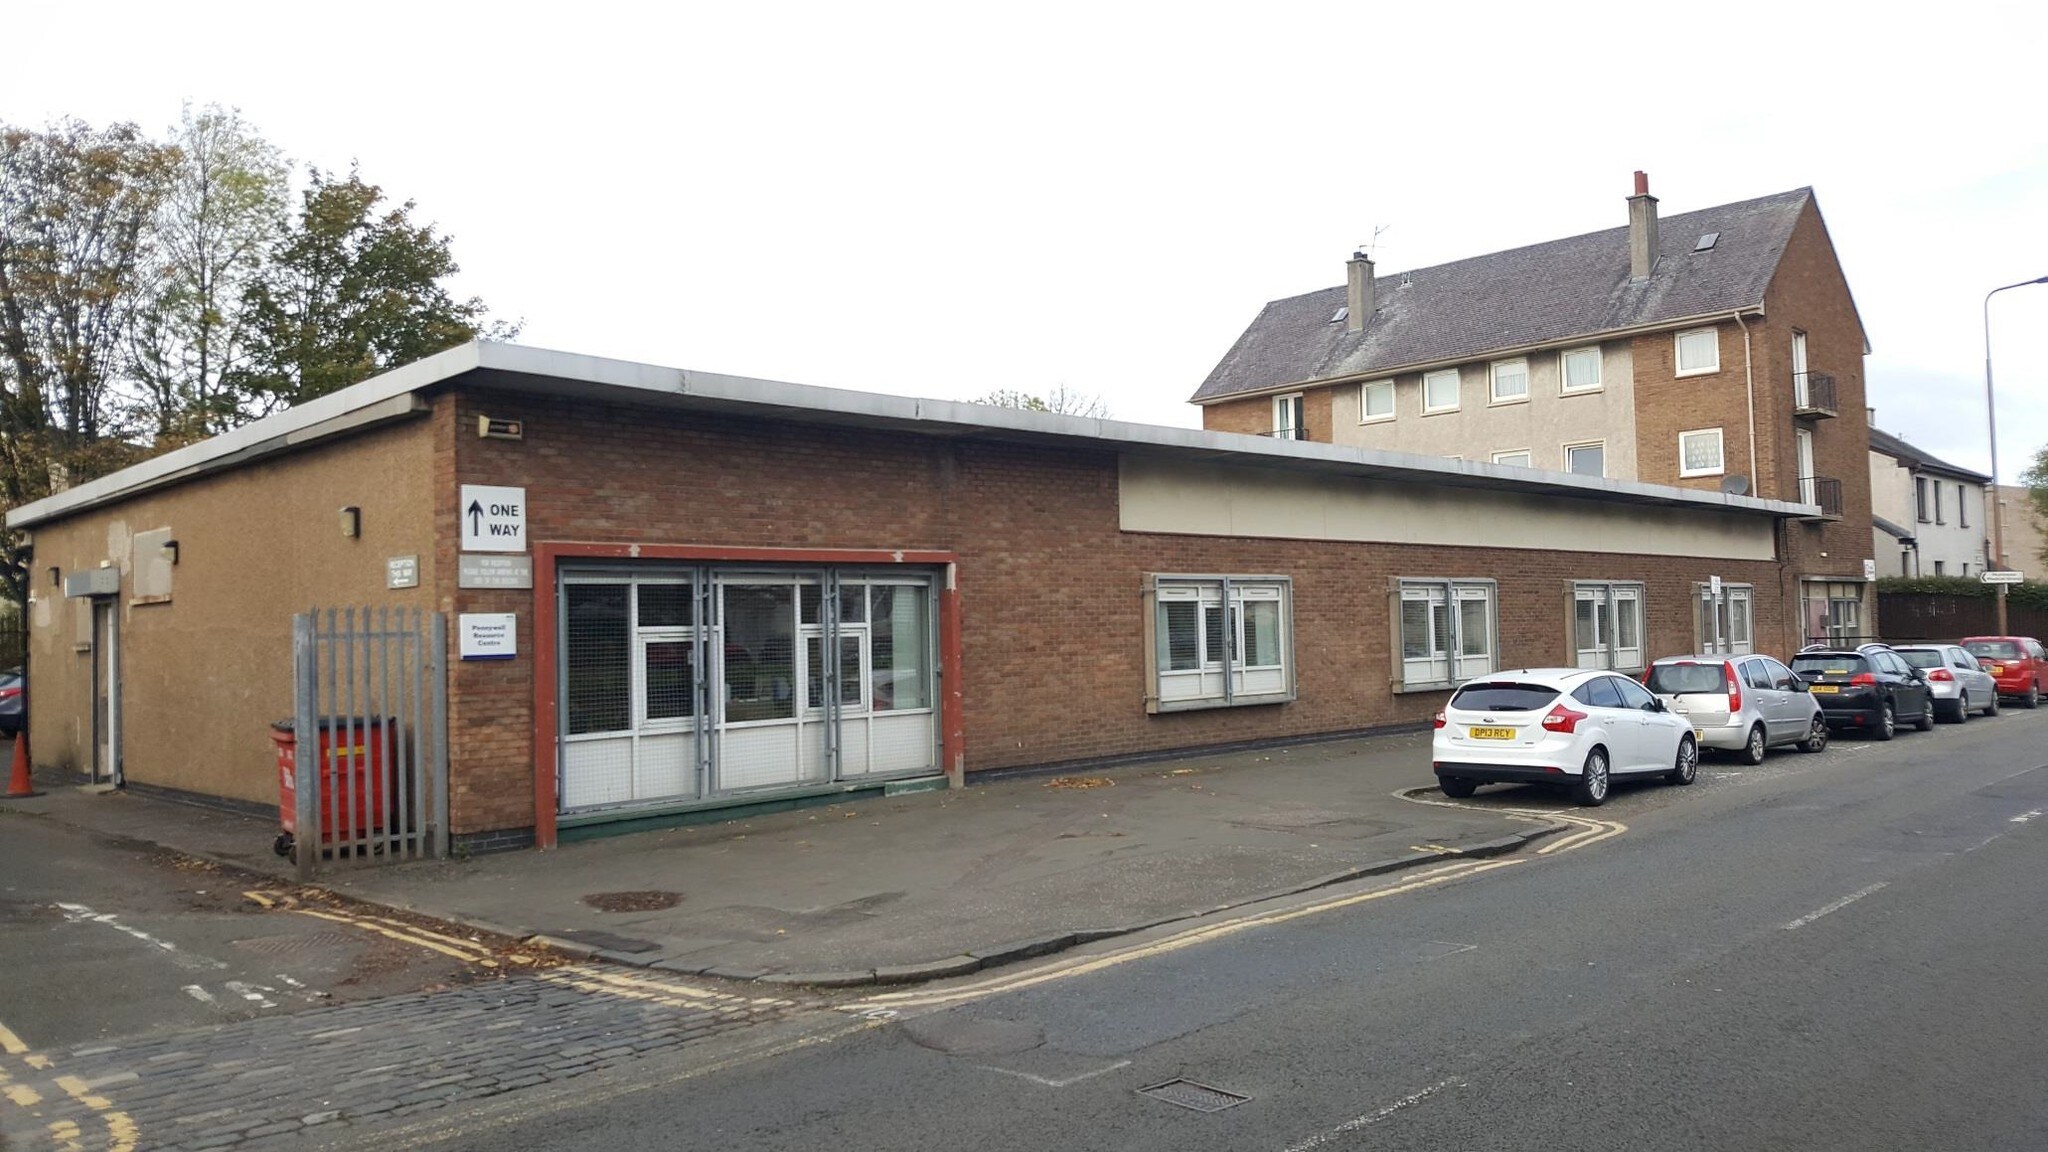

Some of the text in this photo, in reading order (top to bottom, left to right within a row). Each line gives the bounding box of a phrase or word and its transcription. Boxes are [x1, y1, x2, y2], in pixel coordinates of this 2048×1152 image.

[490, 504, 519, 517] ONE
[490, 524, 520, 537] WAY
[473, 632, 505, 640] Resource
[478, 639, 501, 647] Centre
[1475, 727, 1511, 738] DP13 RCY
